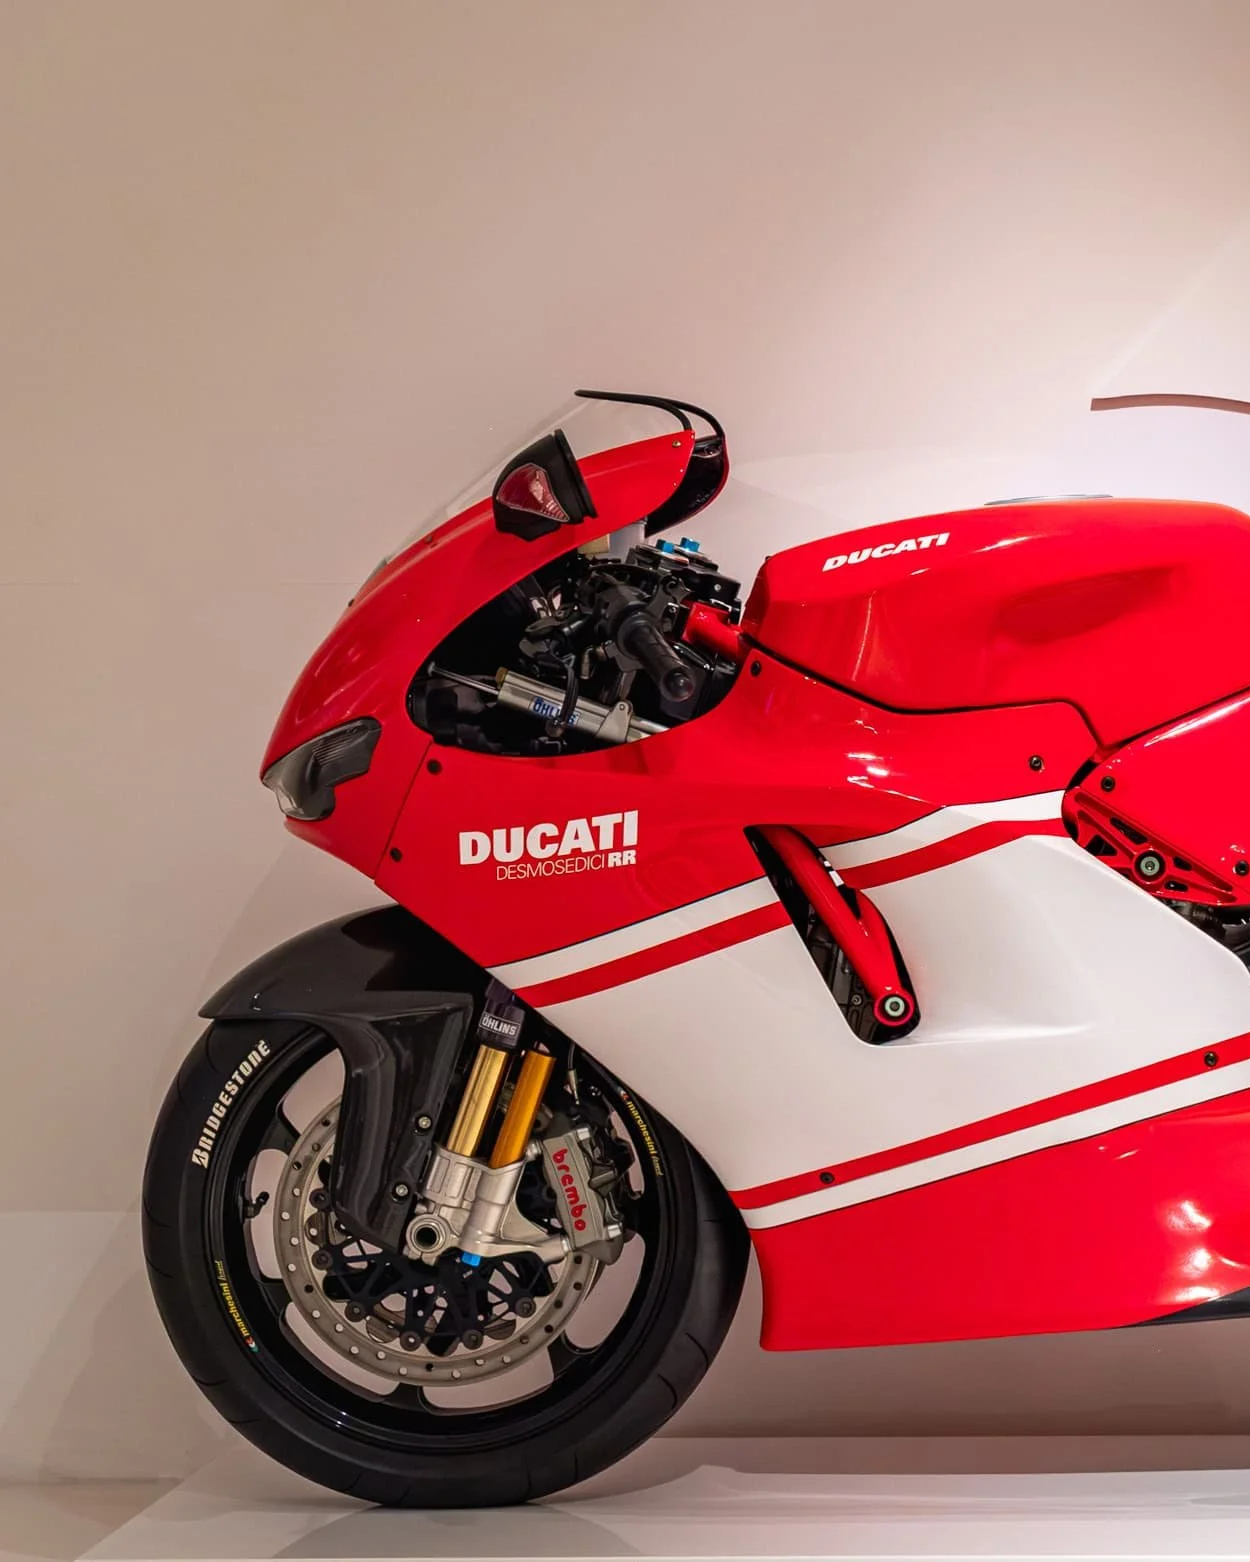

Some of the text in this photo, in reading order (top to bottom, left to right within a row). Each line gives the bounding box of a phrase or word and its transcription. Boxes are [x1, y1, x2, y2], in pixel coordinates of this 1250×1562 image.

[822, 532, 950, 572] DUCATI
[459, 810, 639, 865] DUCATI
[496, 849, 637, 880] DESMOSEDICI RR
[482, 1014, 517, 1036] ÖHLINS
[191, 1039, 270, 1168] BRIDGESTONE
[552, 1148, 588, 1231] brembo
